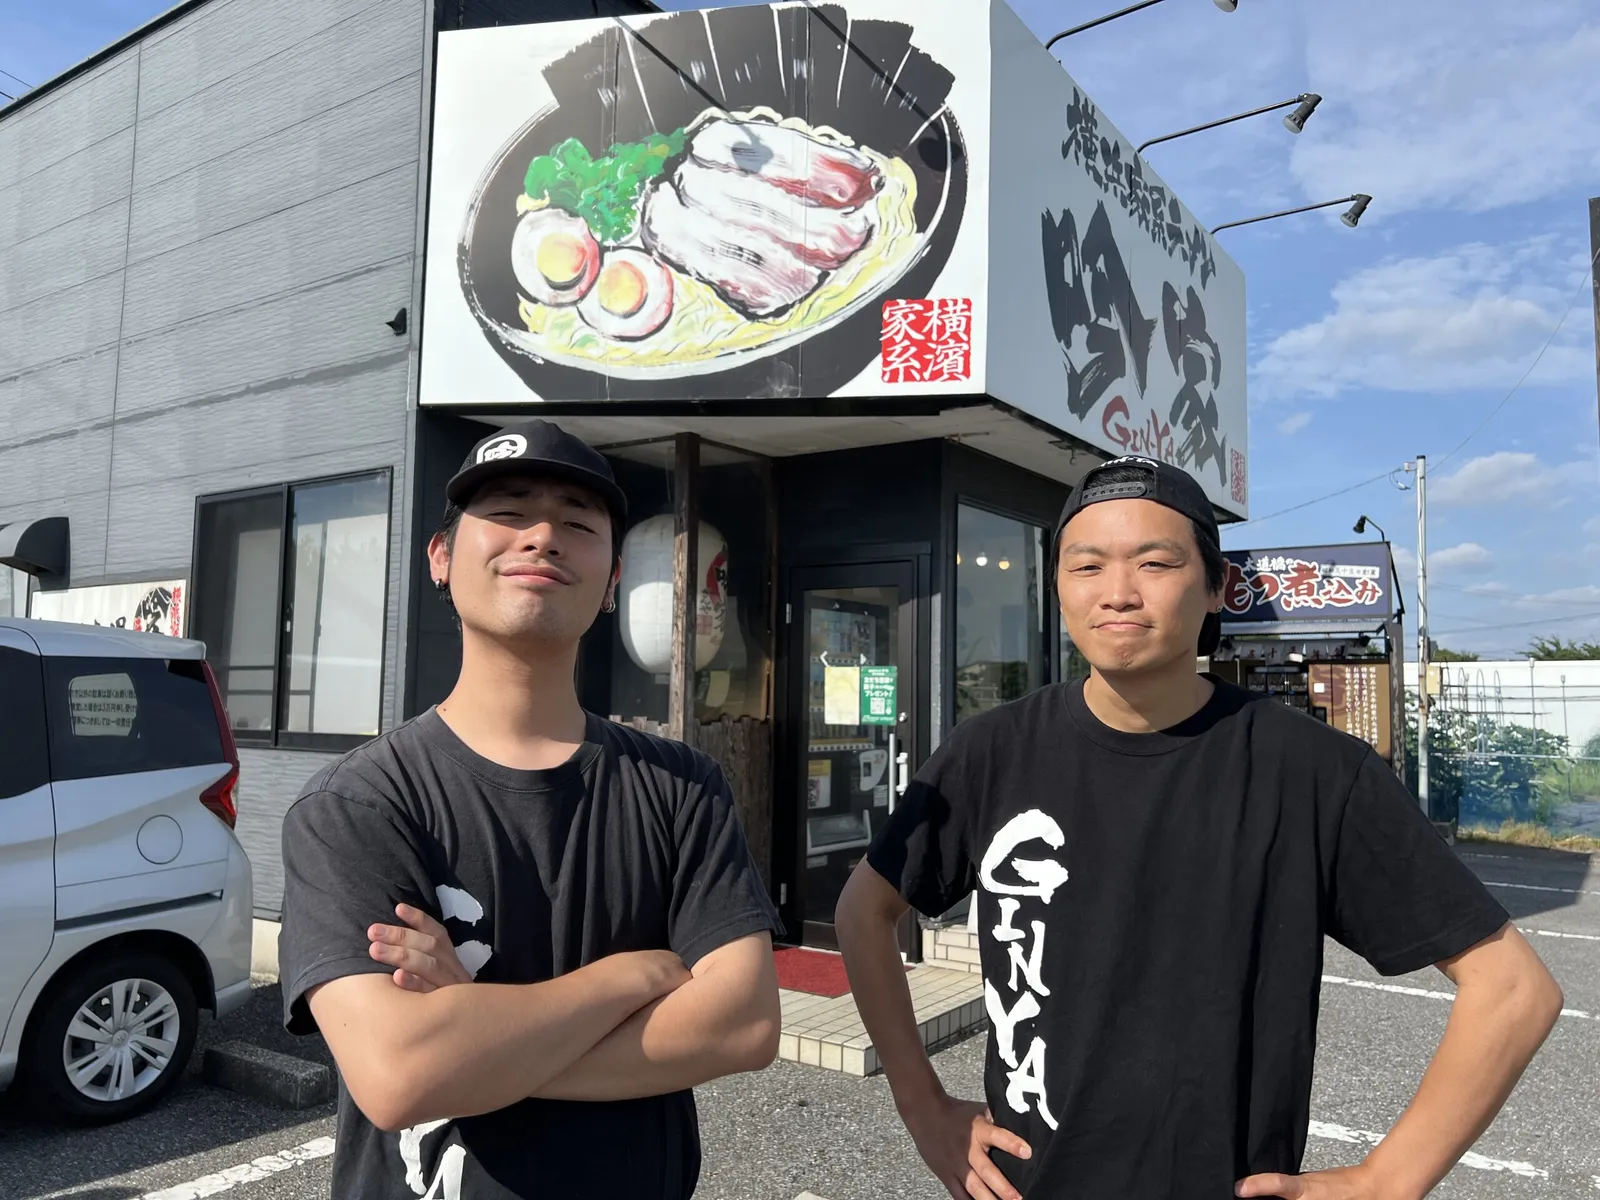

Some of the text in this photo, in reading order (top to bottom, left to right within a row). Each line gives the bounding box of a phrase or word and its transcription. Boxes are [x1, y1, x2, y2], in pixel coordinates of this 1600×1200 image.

[1242, 555, 1294, 572] 水道橋の
[1223, 558, 1384, 615] もつ煮込み
